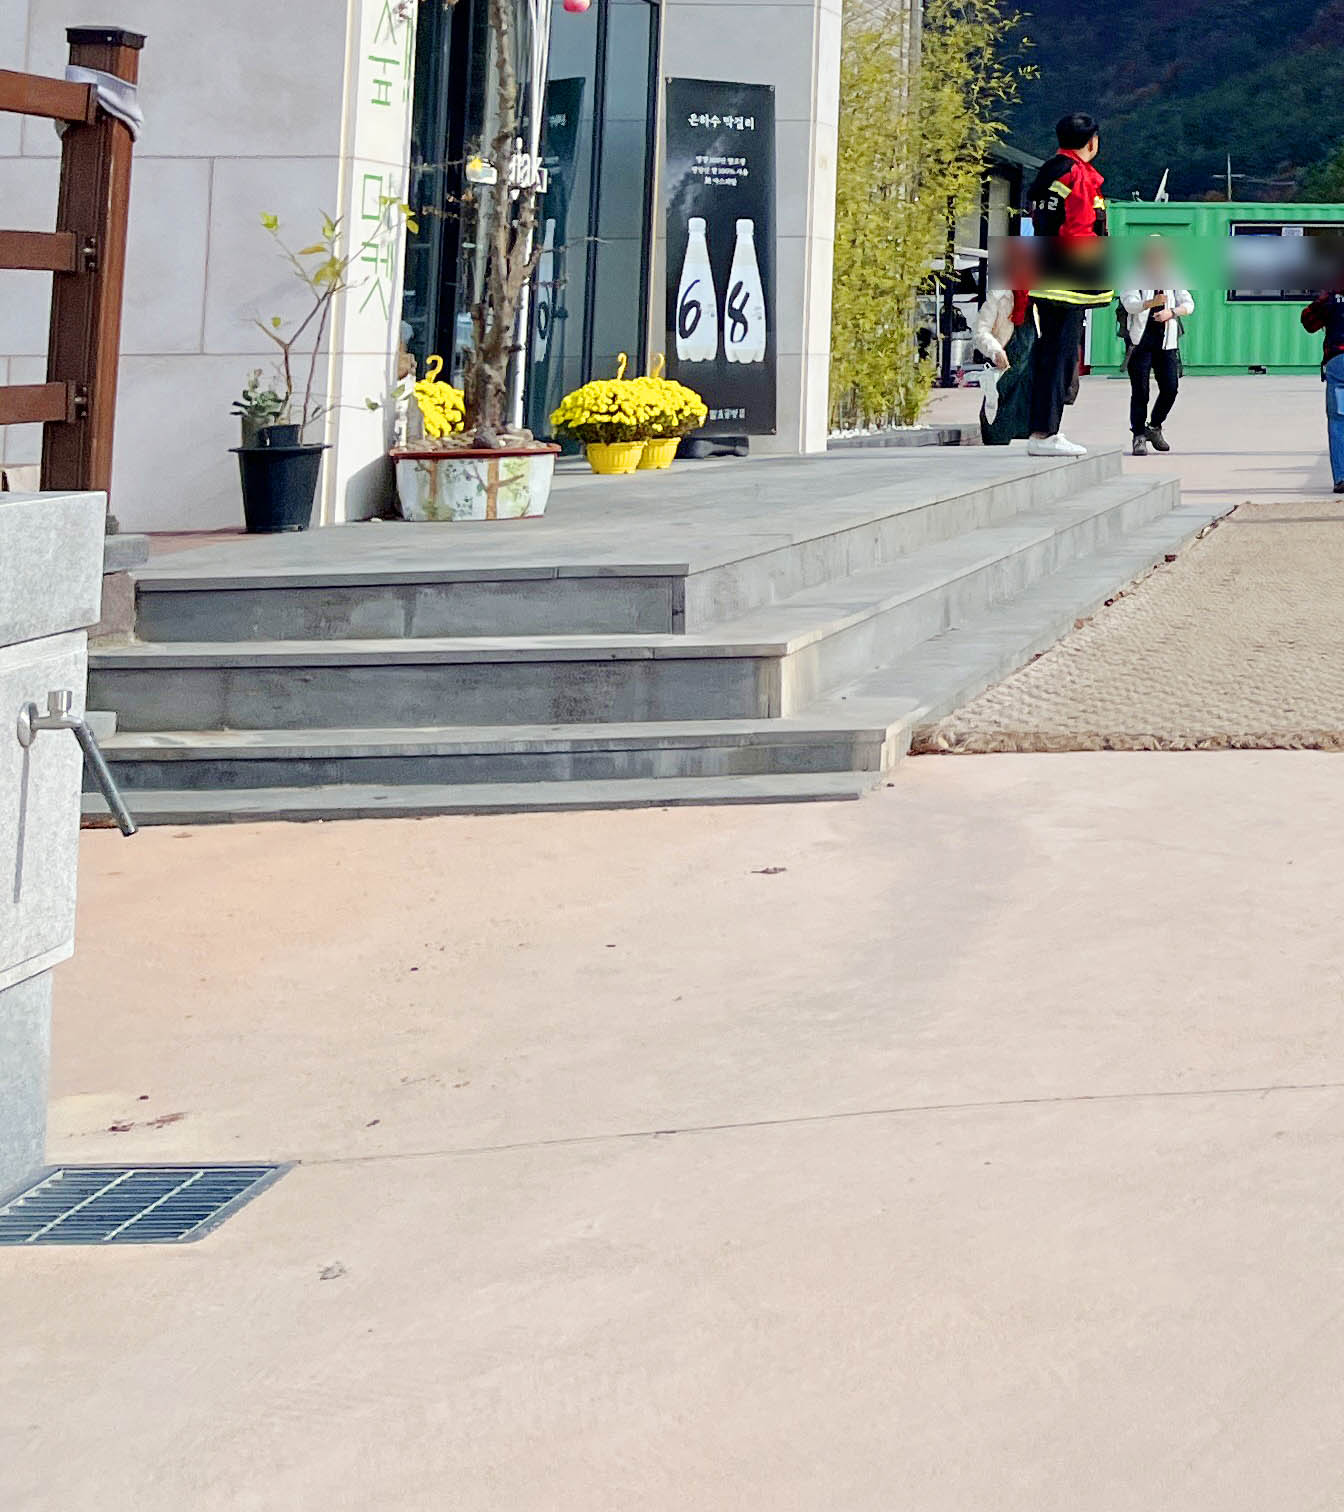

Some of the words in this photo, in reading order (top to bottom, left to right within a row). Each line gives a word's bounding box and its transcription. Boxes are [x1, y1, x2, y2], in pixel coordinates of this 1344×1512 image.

[688, 113, 721, 128] 은하수
[723, 115, 755, 131] 막걸리
[679, 279, 701, 339] 6
[728, 280, 750, 344] 8
